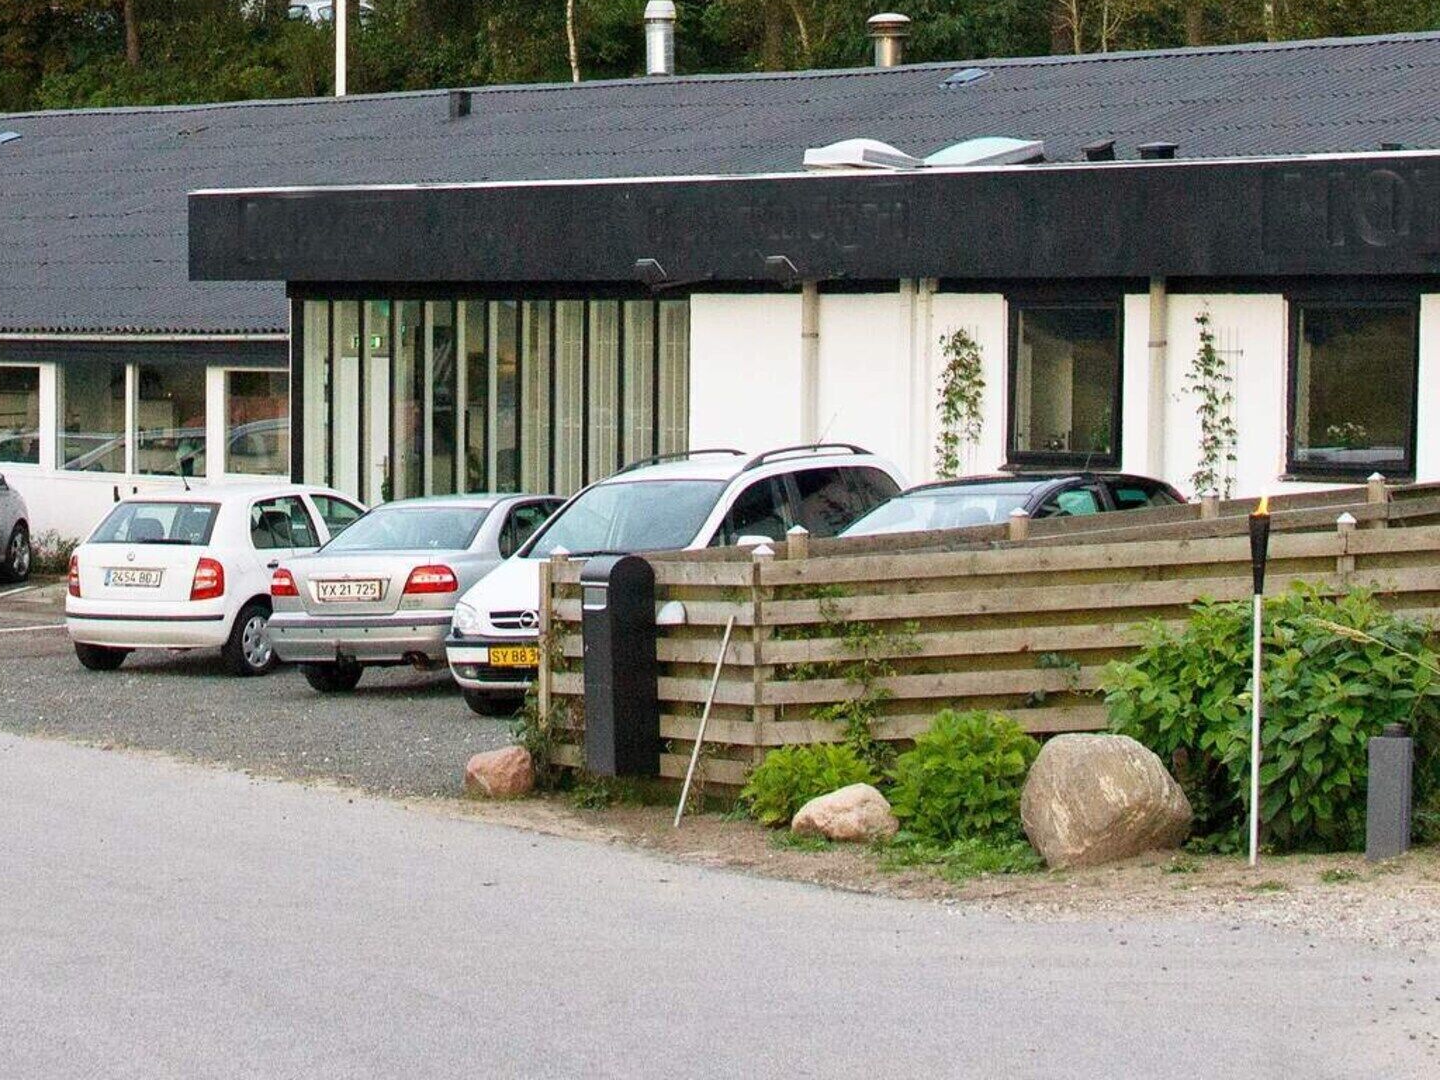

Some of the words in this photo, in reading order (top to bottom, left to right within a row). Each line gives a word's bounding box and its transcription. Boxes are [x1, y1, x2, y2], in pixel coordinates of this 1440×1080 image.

[320, 584, 337, 596] YX
[339, 584, 352, 596] 21
[355, 583, 377, 596] 725
[491, 650, 509, 663] SY
